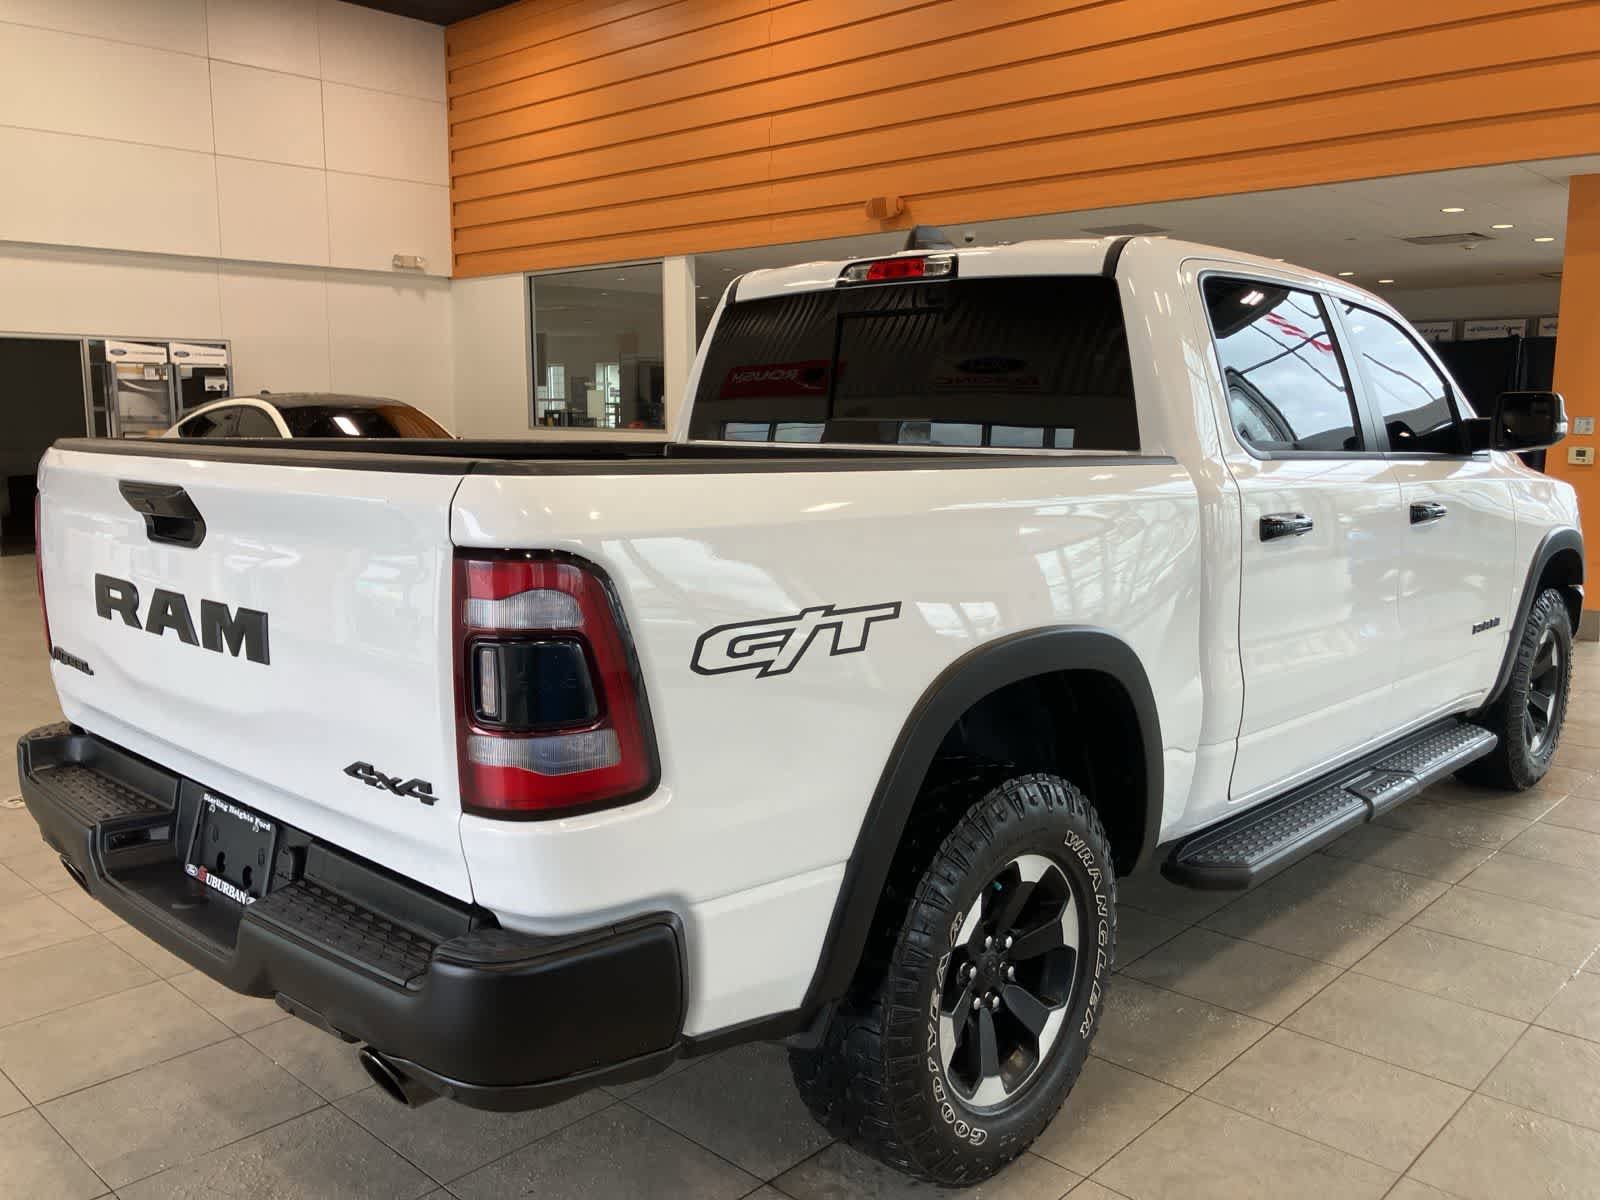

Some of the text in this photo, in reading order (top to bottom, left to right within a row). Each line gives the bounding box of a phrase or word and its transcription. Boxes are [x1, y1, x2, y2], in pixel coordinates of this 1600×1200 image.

[95, 573, 270, 665] RAM
[198, 865, 247, 904] SUBURBAN
[1064, 830, 1109, 1039] WRANGLER
